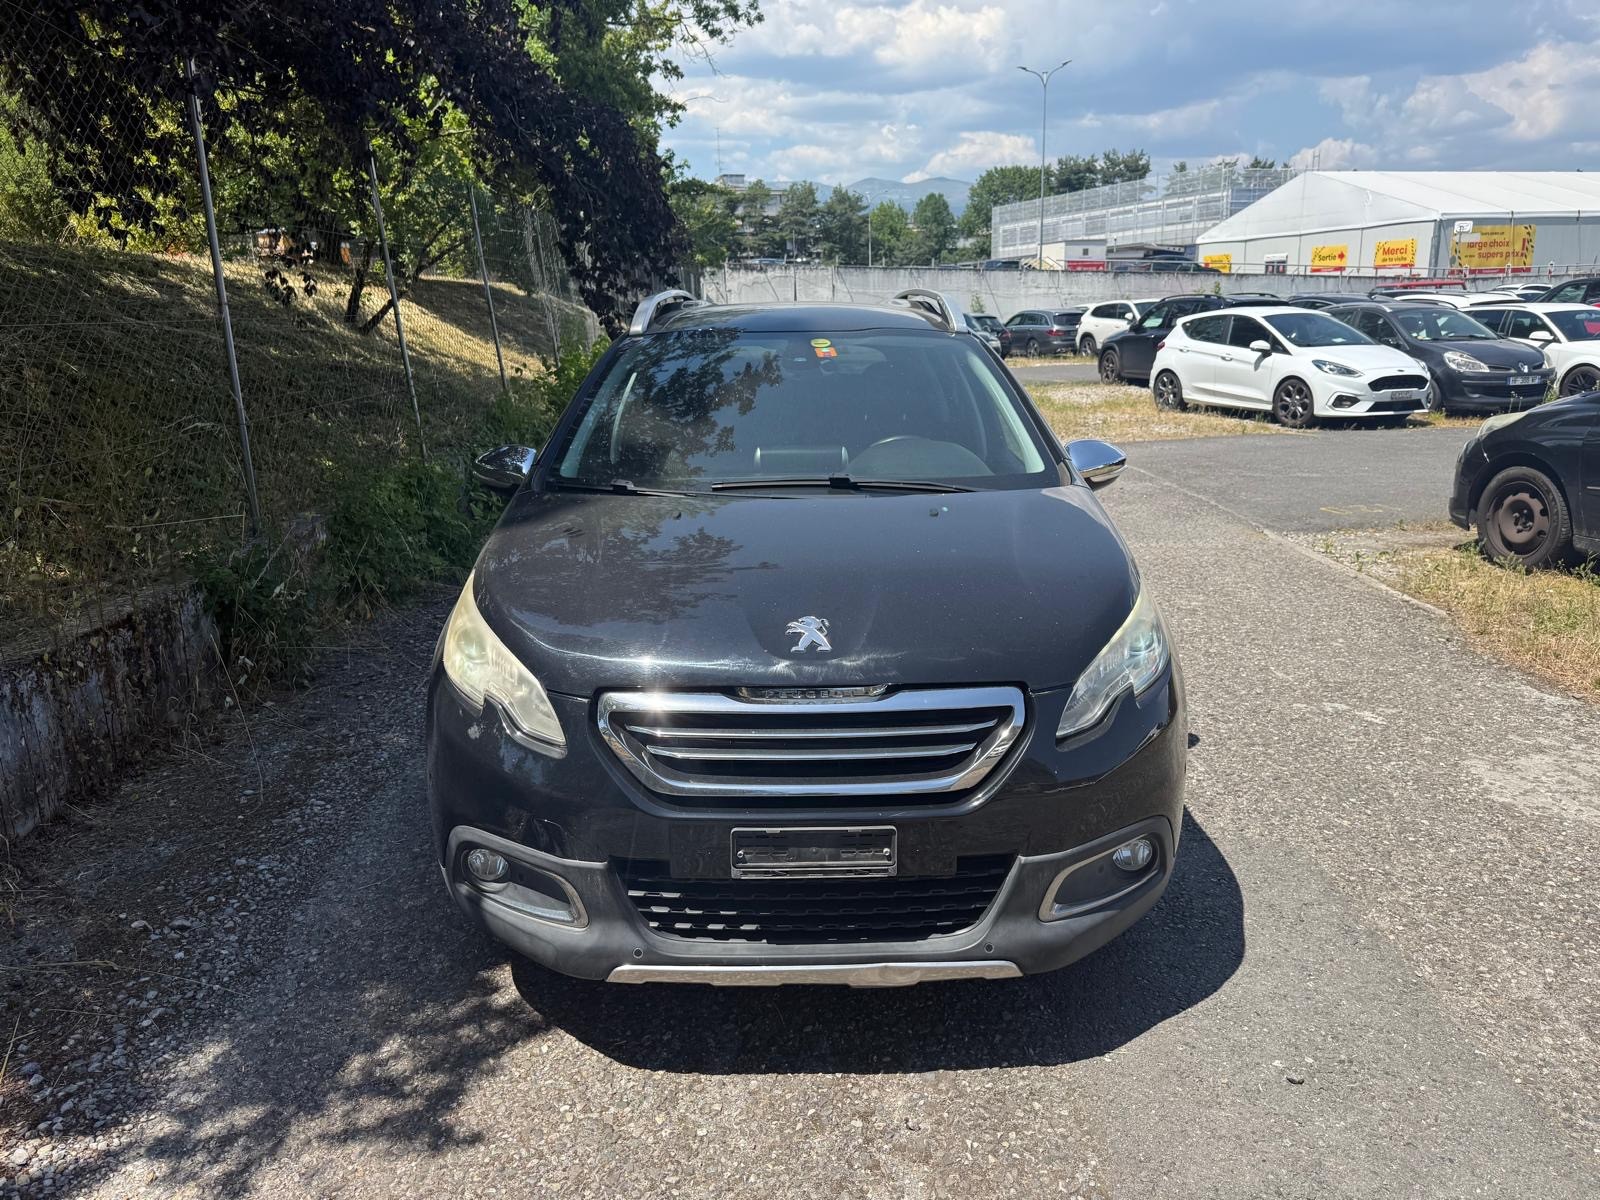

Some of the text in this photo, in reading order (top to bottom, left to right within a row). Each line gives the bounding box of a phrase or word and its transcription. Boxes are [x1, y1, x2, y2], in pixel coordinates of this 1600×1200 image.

[1489, 238, 1510, 248] choix
[1382, 245, 1408, 256] Merci
[1318, 254, 1337, 262] Sortie
[1477, 251, 1504, 261] supers
